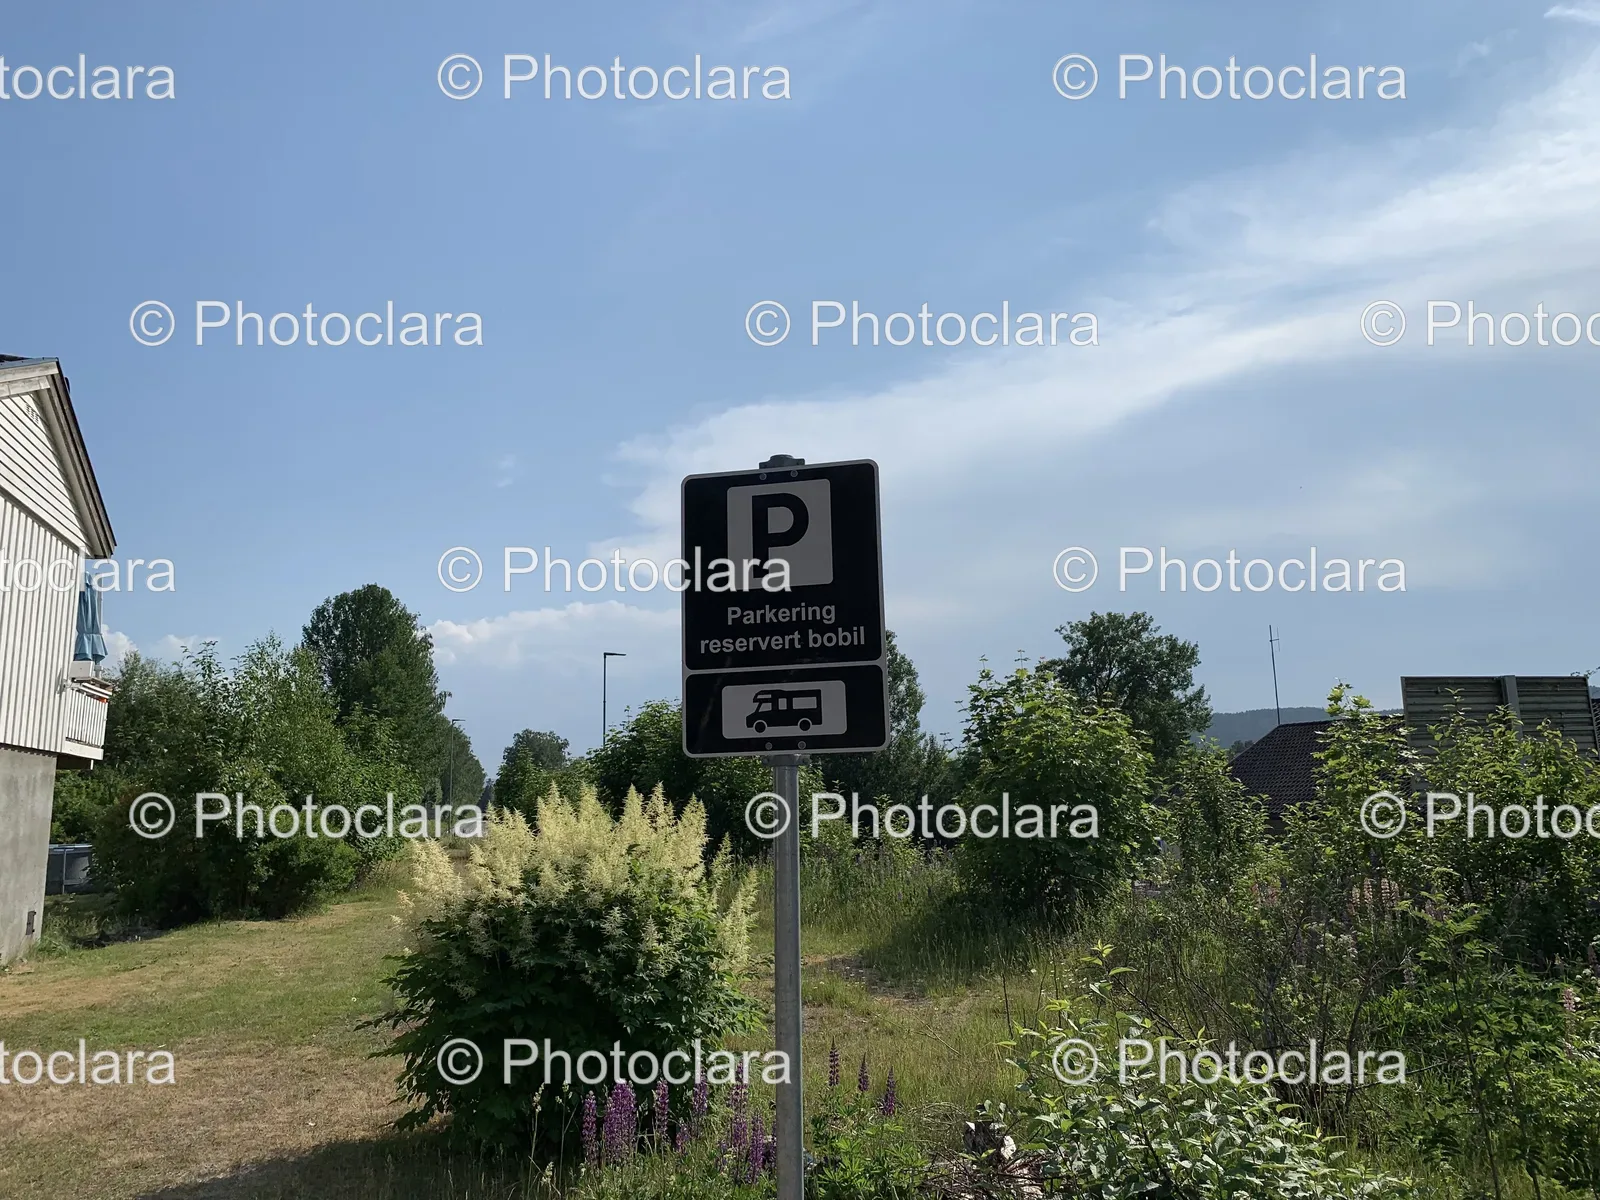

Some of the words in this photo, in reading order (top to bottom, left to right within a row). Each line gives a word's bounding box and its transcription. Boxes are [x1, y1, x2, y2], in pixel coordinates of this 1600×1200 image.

[752, 493, 809, 579] P
[727, 602, 836, 625] Parkering
[700, 630, 801, 654] reservert
[808, 626, 865, 648] bobil
